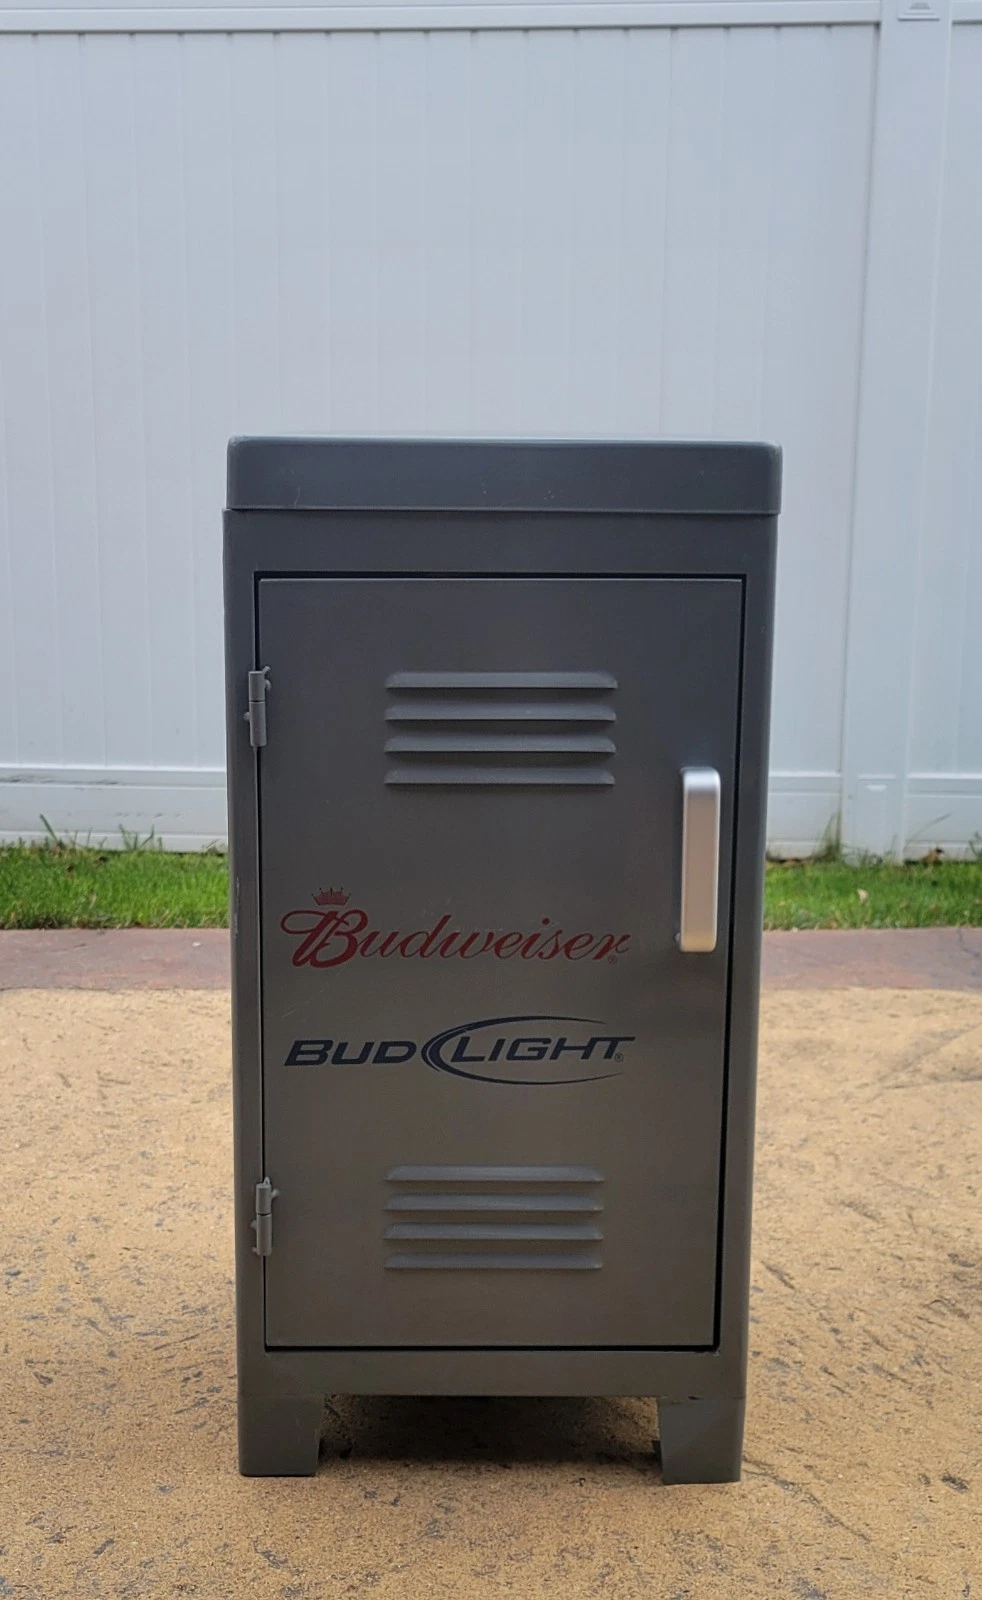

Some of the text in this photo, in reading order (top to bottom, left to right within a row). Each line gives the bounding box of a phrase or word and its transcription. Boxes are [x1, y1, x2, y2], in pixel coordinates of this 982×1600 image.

[280, 908, 632, 968] Budweiser
[283, 1035, 636, 1067] BUD LIGHT
